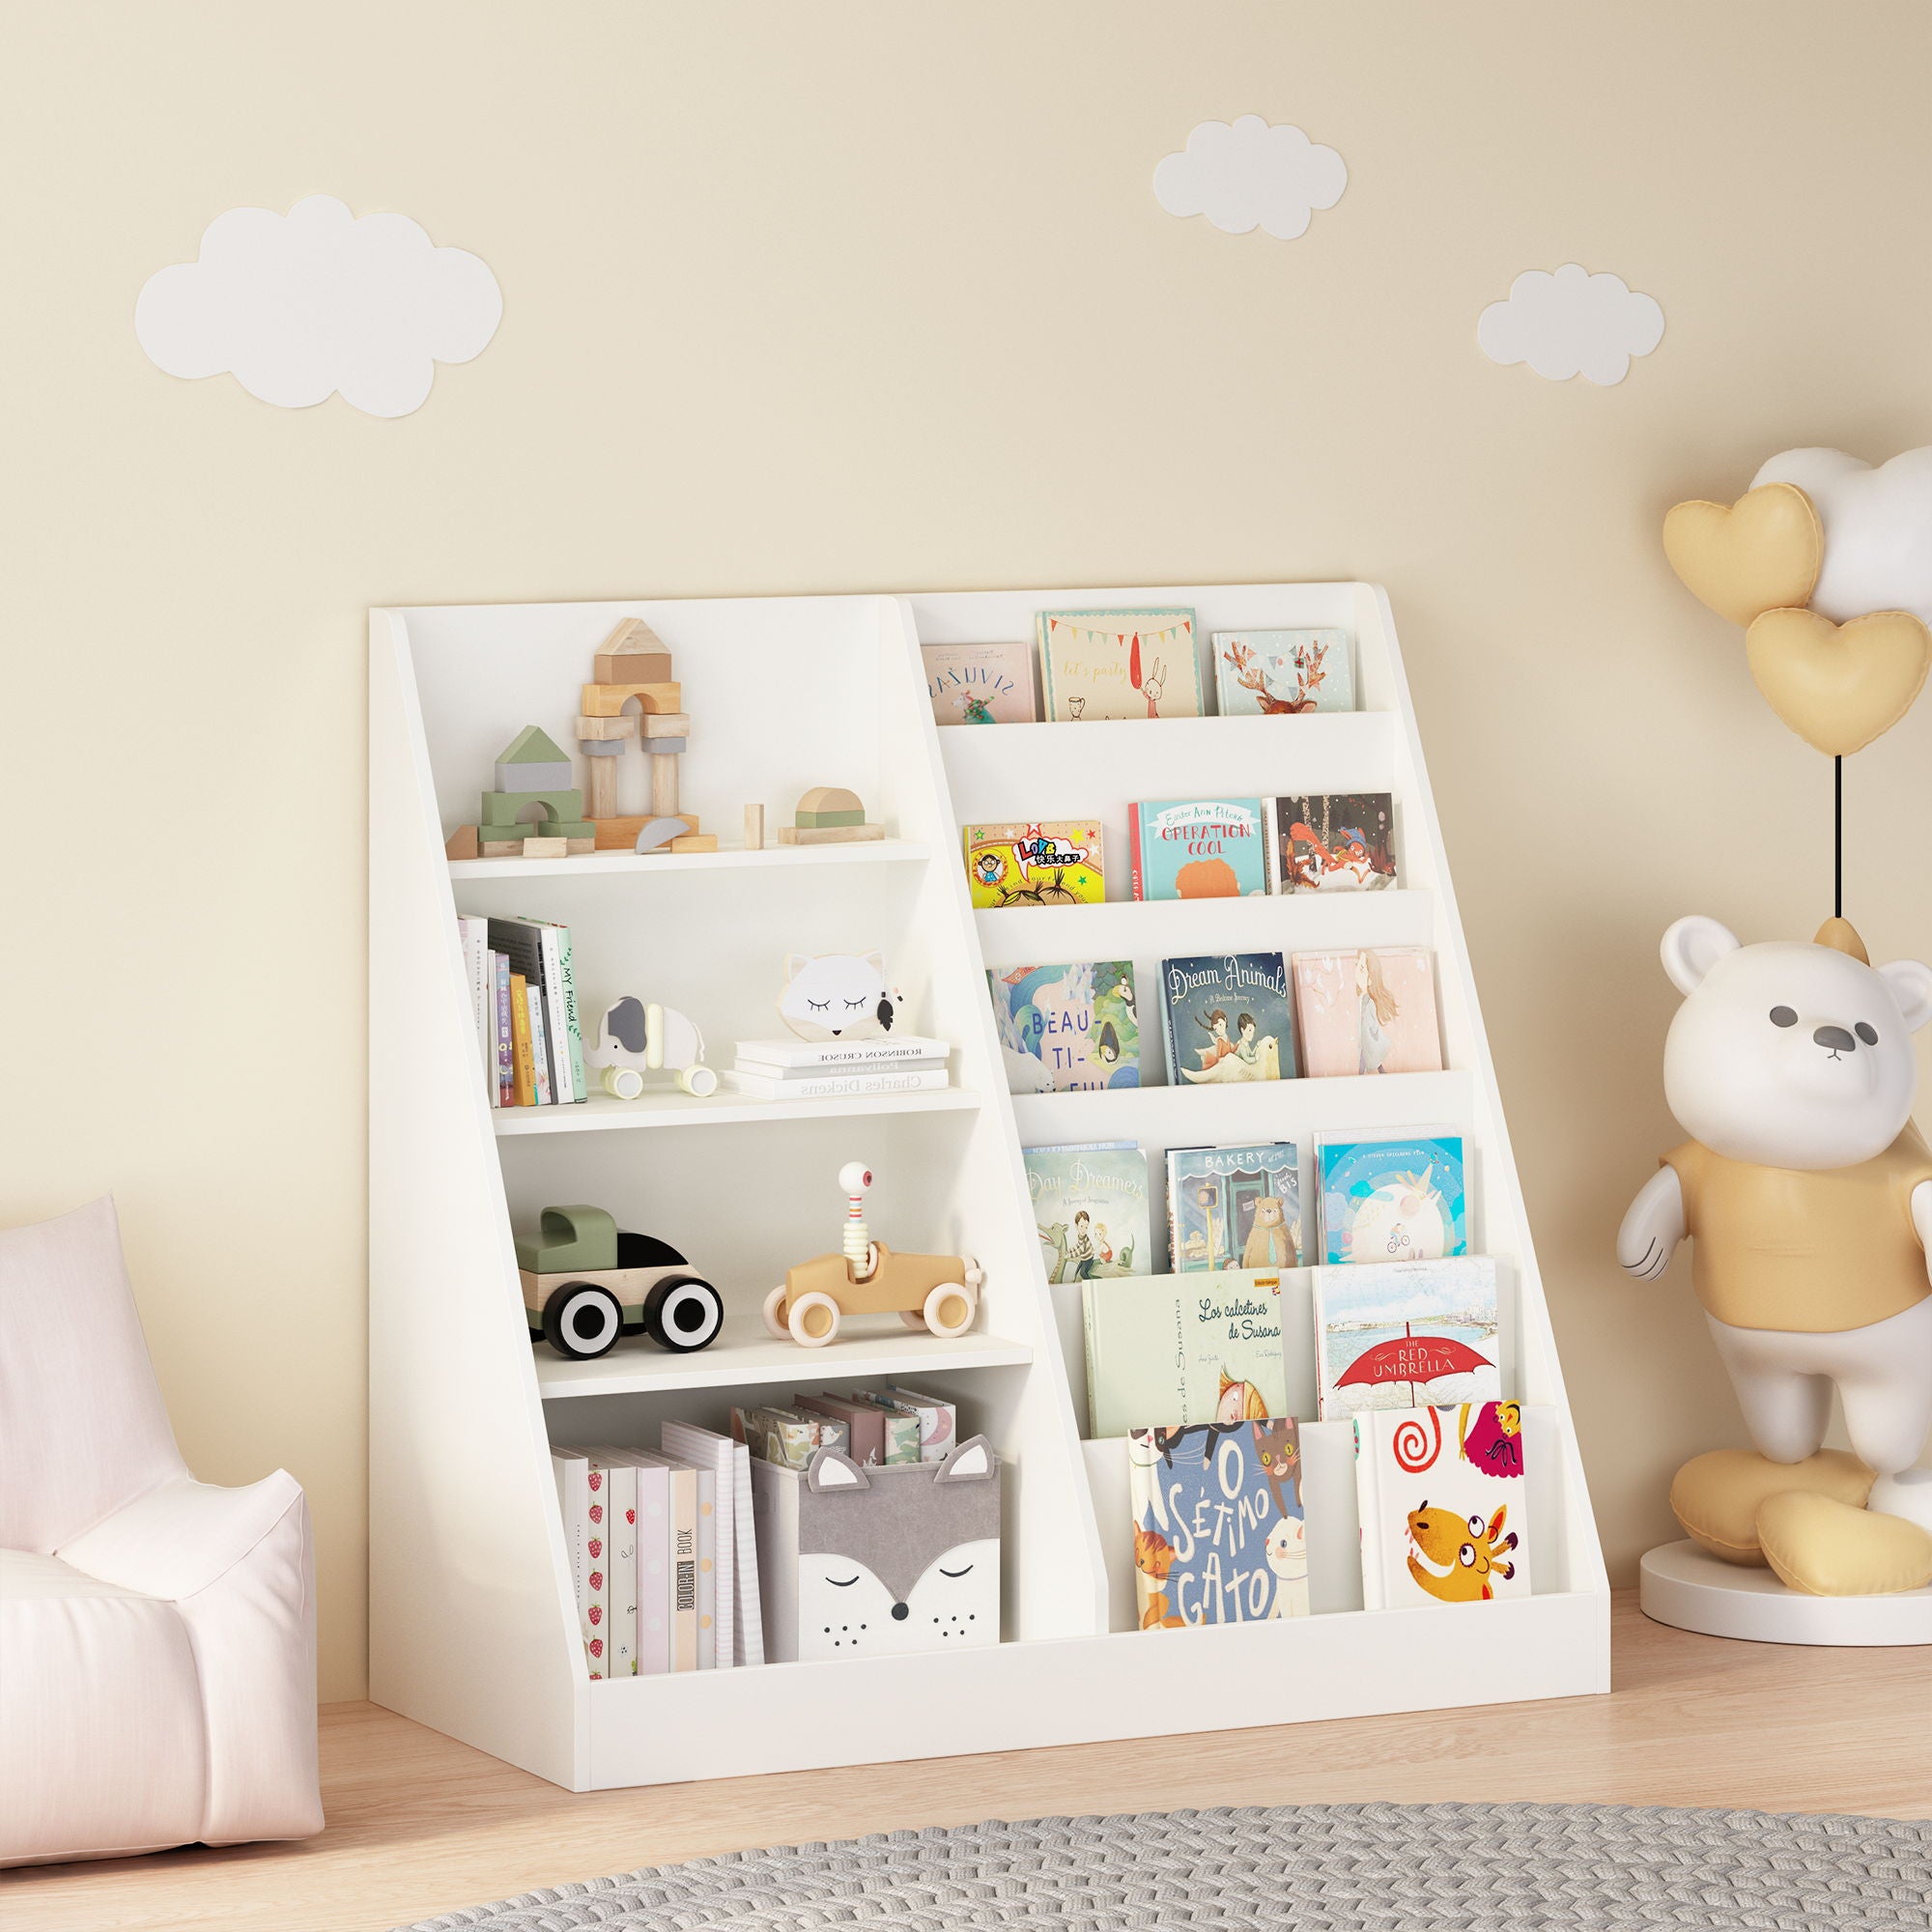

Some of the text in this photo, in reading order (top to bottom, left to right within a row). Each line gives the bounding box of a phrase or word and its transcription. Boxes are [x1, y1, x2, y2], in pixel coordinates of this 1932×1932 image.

[1161, 823, 1251, 841] OPERATION
[1187, 840, 1227, 856] COOL
[1036, 854, 1081, 867] 快乐大鼻子
[1168, 954, 1287, 1005] Dream Animals
[561, 968, 578, 1022] MY Friend
[1032, 1009, 1102, 1035] BEAU-
[1052, 1047, 1085, 1069] TI-
[1205, 1151, 1264, 1168] BAKERY
[1068, 1159, 1144, 1199] Dreamers
[1198, 1298, 1268, 1322] Los calcetines
[1229, 1320, 1282, 1340] de Susana
[1399, 1348, 1428, 1361] RED
[1374, 1358, 1456, 1378] UMBRELLA
[1217, 1439, 1244, 1499] O
[677, 1529, 693, 1554] BOOK
[1177, 1551, 1269, 1627] GATO
